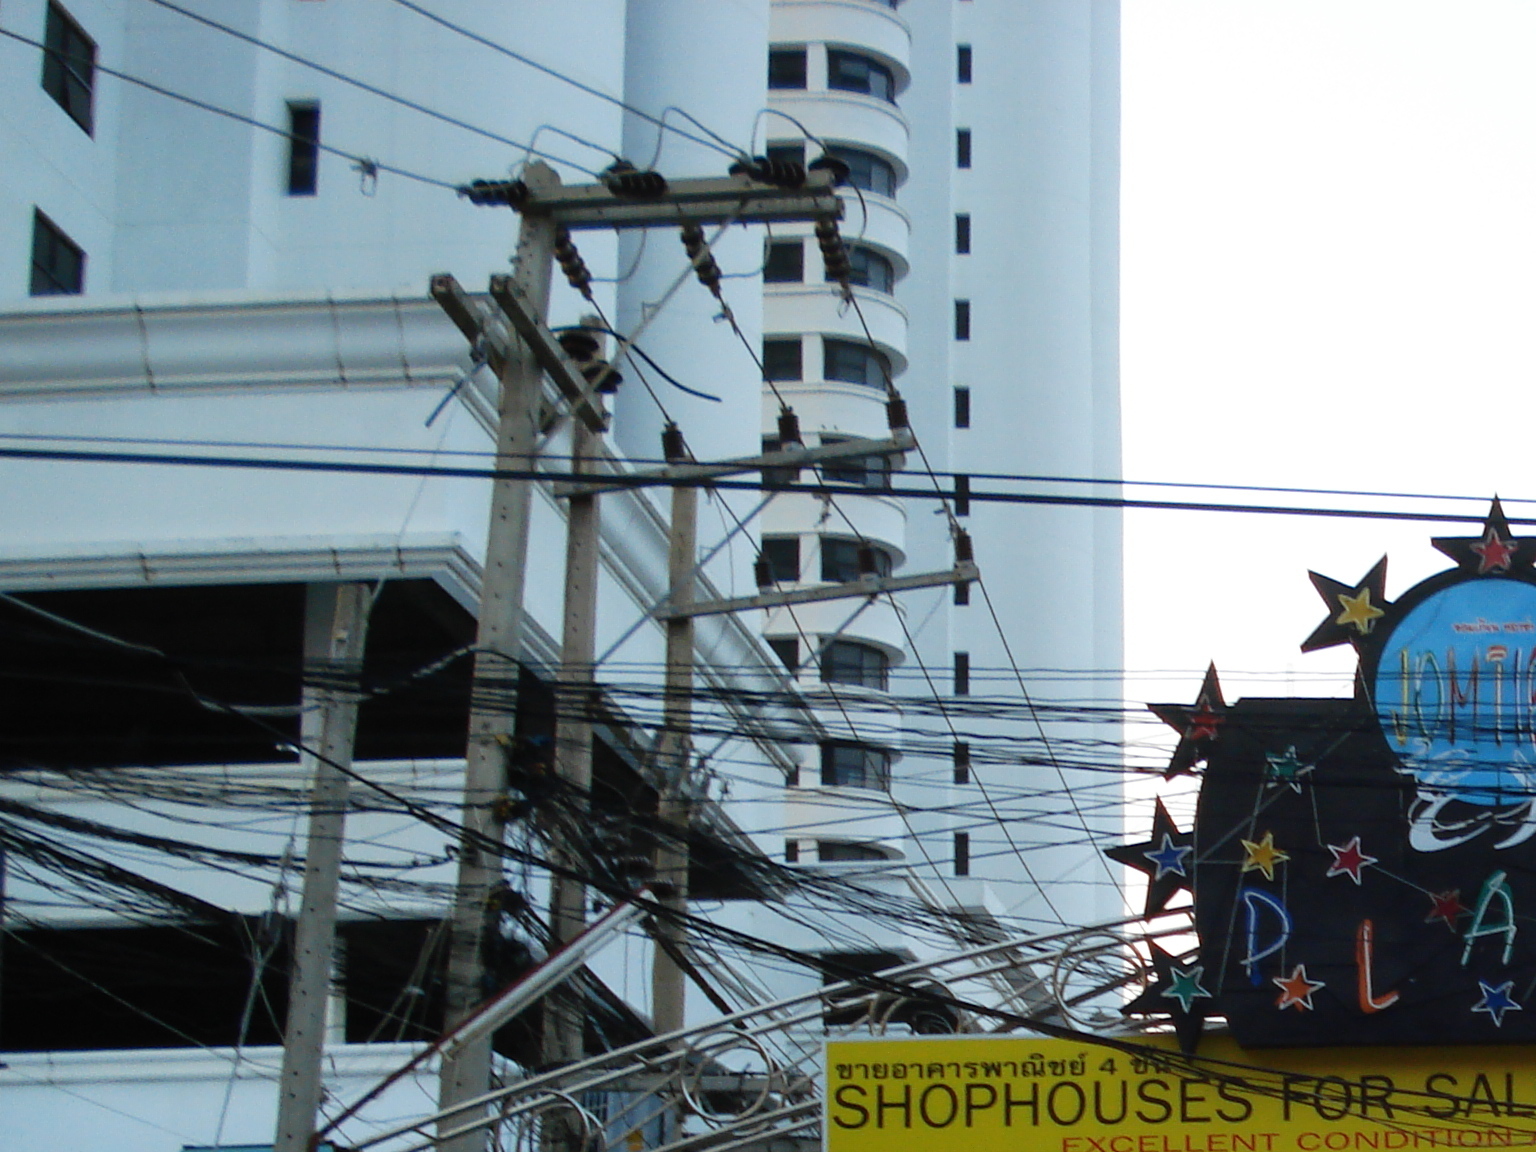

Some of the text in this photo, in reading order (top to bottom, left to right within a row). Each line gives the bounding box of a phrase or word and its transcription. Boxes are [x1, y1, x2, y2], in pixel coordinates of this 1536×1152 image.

[834, 1051, 1088, 1081] ขายอาคารพาณิชย์
[1099, 1058, 1117, 1076] 4
[833, 1074, 1254, 1130] SHOPHOUSES
[1281, 1072, 1395, 1123] FOR
[1297, 1127, 1513, 1152] CONDITION
